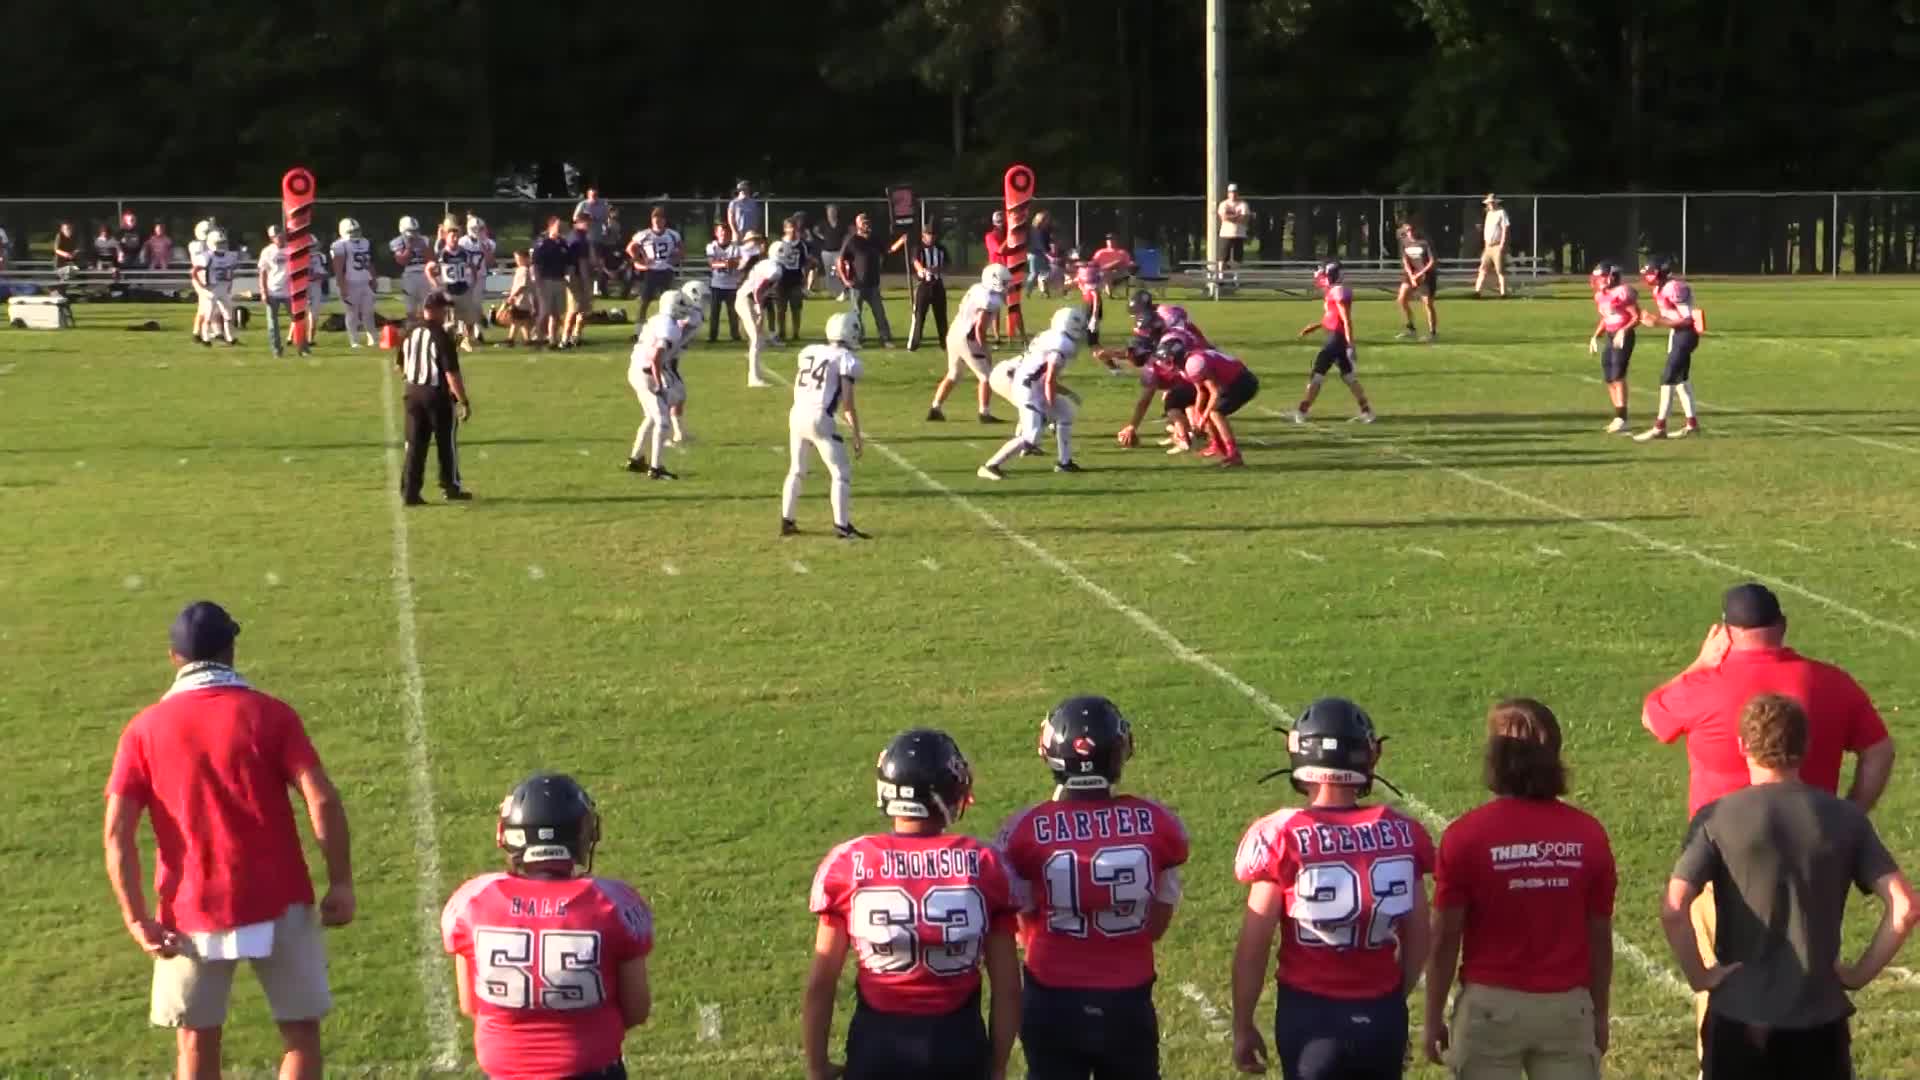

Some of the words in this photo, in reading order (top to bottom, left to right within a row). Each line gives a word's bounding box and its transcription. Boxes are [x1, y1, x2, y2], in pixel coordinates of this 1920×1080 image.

[799, 355, 829, 390] 24
[1034, 808, 1154, 844] CARTER
[1294, 817, 1413, 855] FEENEY
[853, 851, 874, 880] Z.
[880, 847, 980, 878] JHONSON
[1490, 841, 1584, 861] THERASPORT
[1043, 844, 1156, 938] 13
[1292, 855, 1415, 950] 22
[849, 885, 988, 976] 63
[473, 924, 606, 1010] 55
